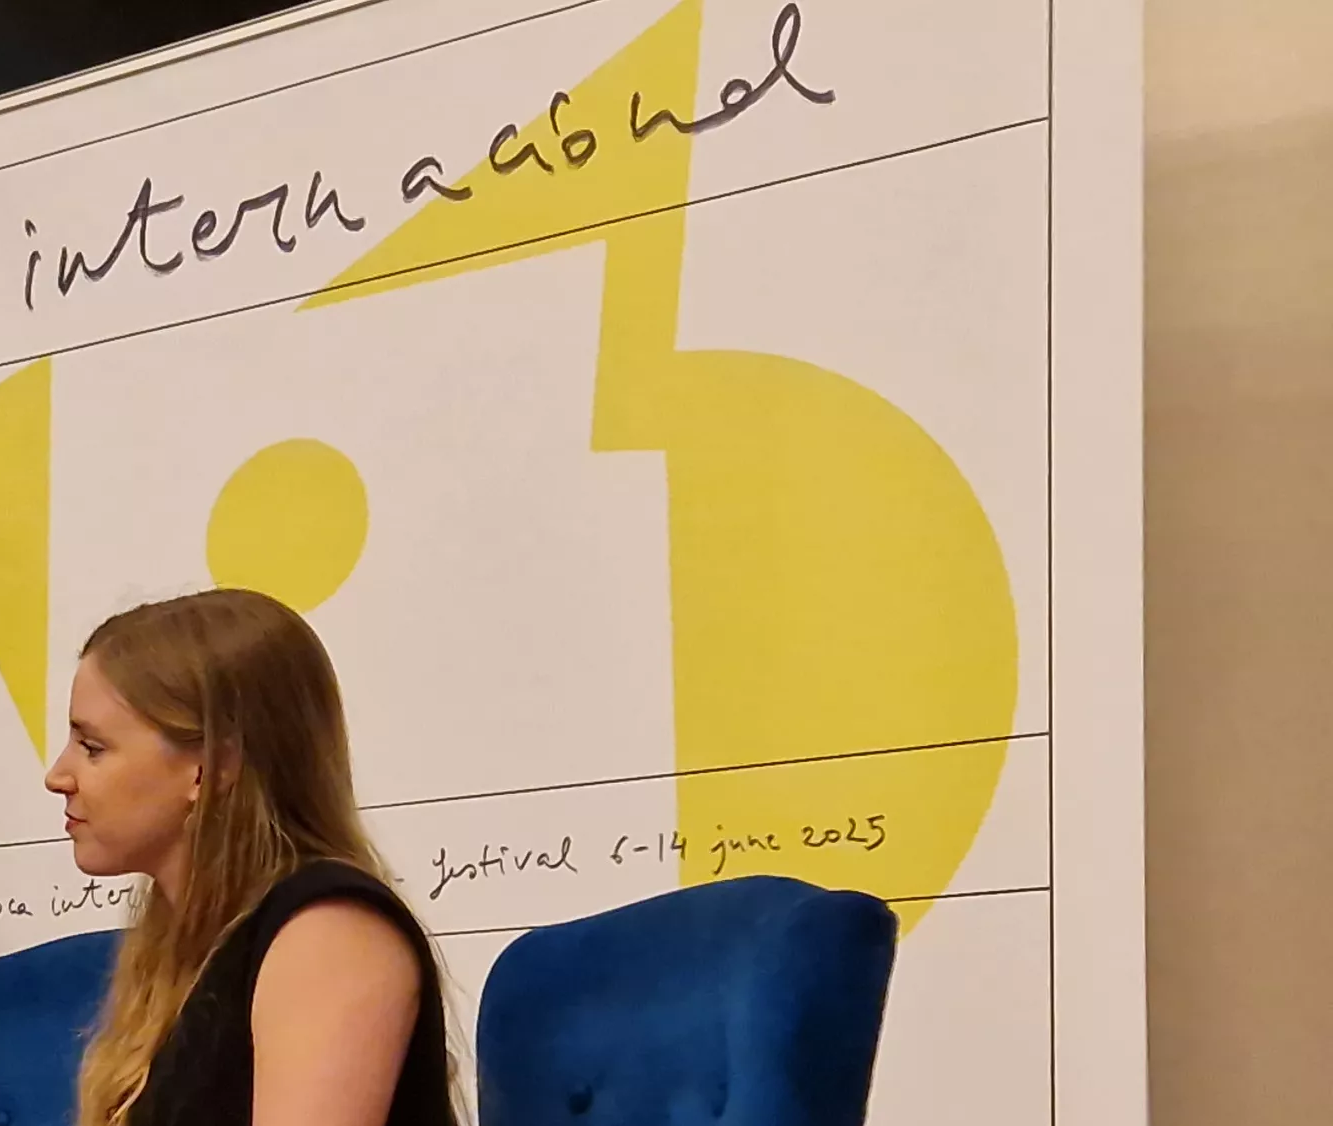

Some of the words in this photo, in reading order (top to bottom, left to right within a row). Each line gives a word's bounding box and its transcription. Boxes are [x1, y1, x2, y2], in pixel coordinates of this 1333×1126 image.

[430, 837, 578, 900] festival
[610, 832, 687, 865] 6-14
[711, 824, 781, 875] june
[801, 814, 886, 850] 2025
